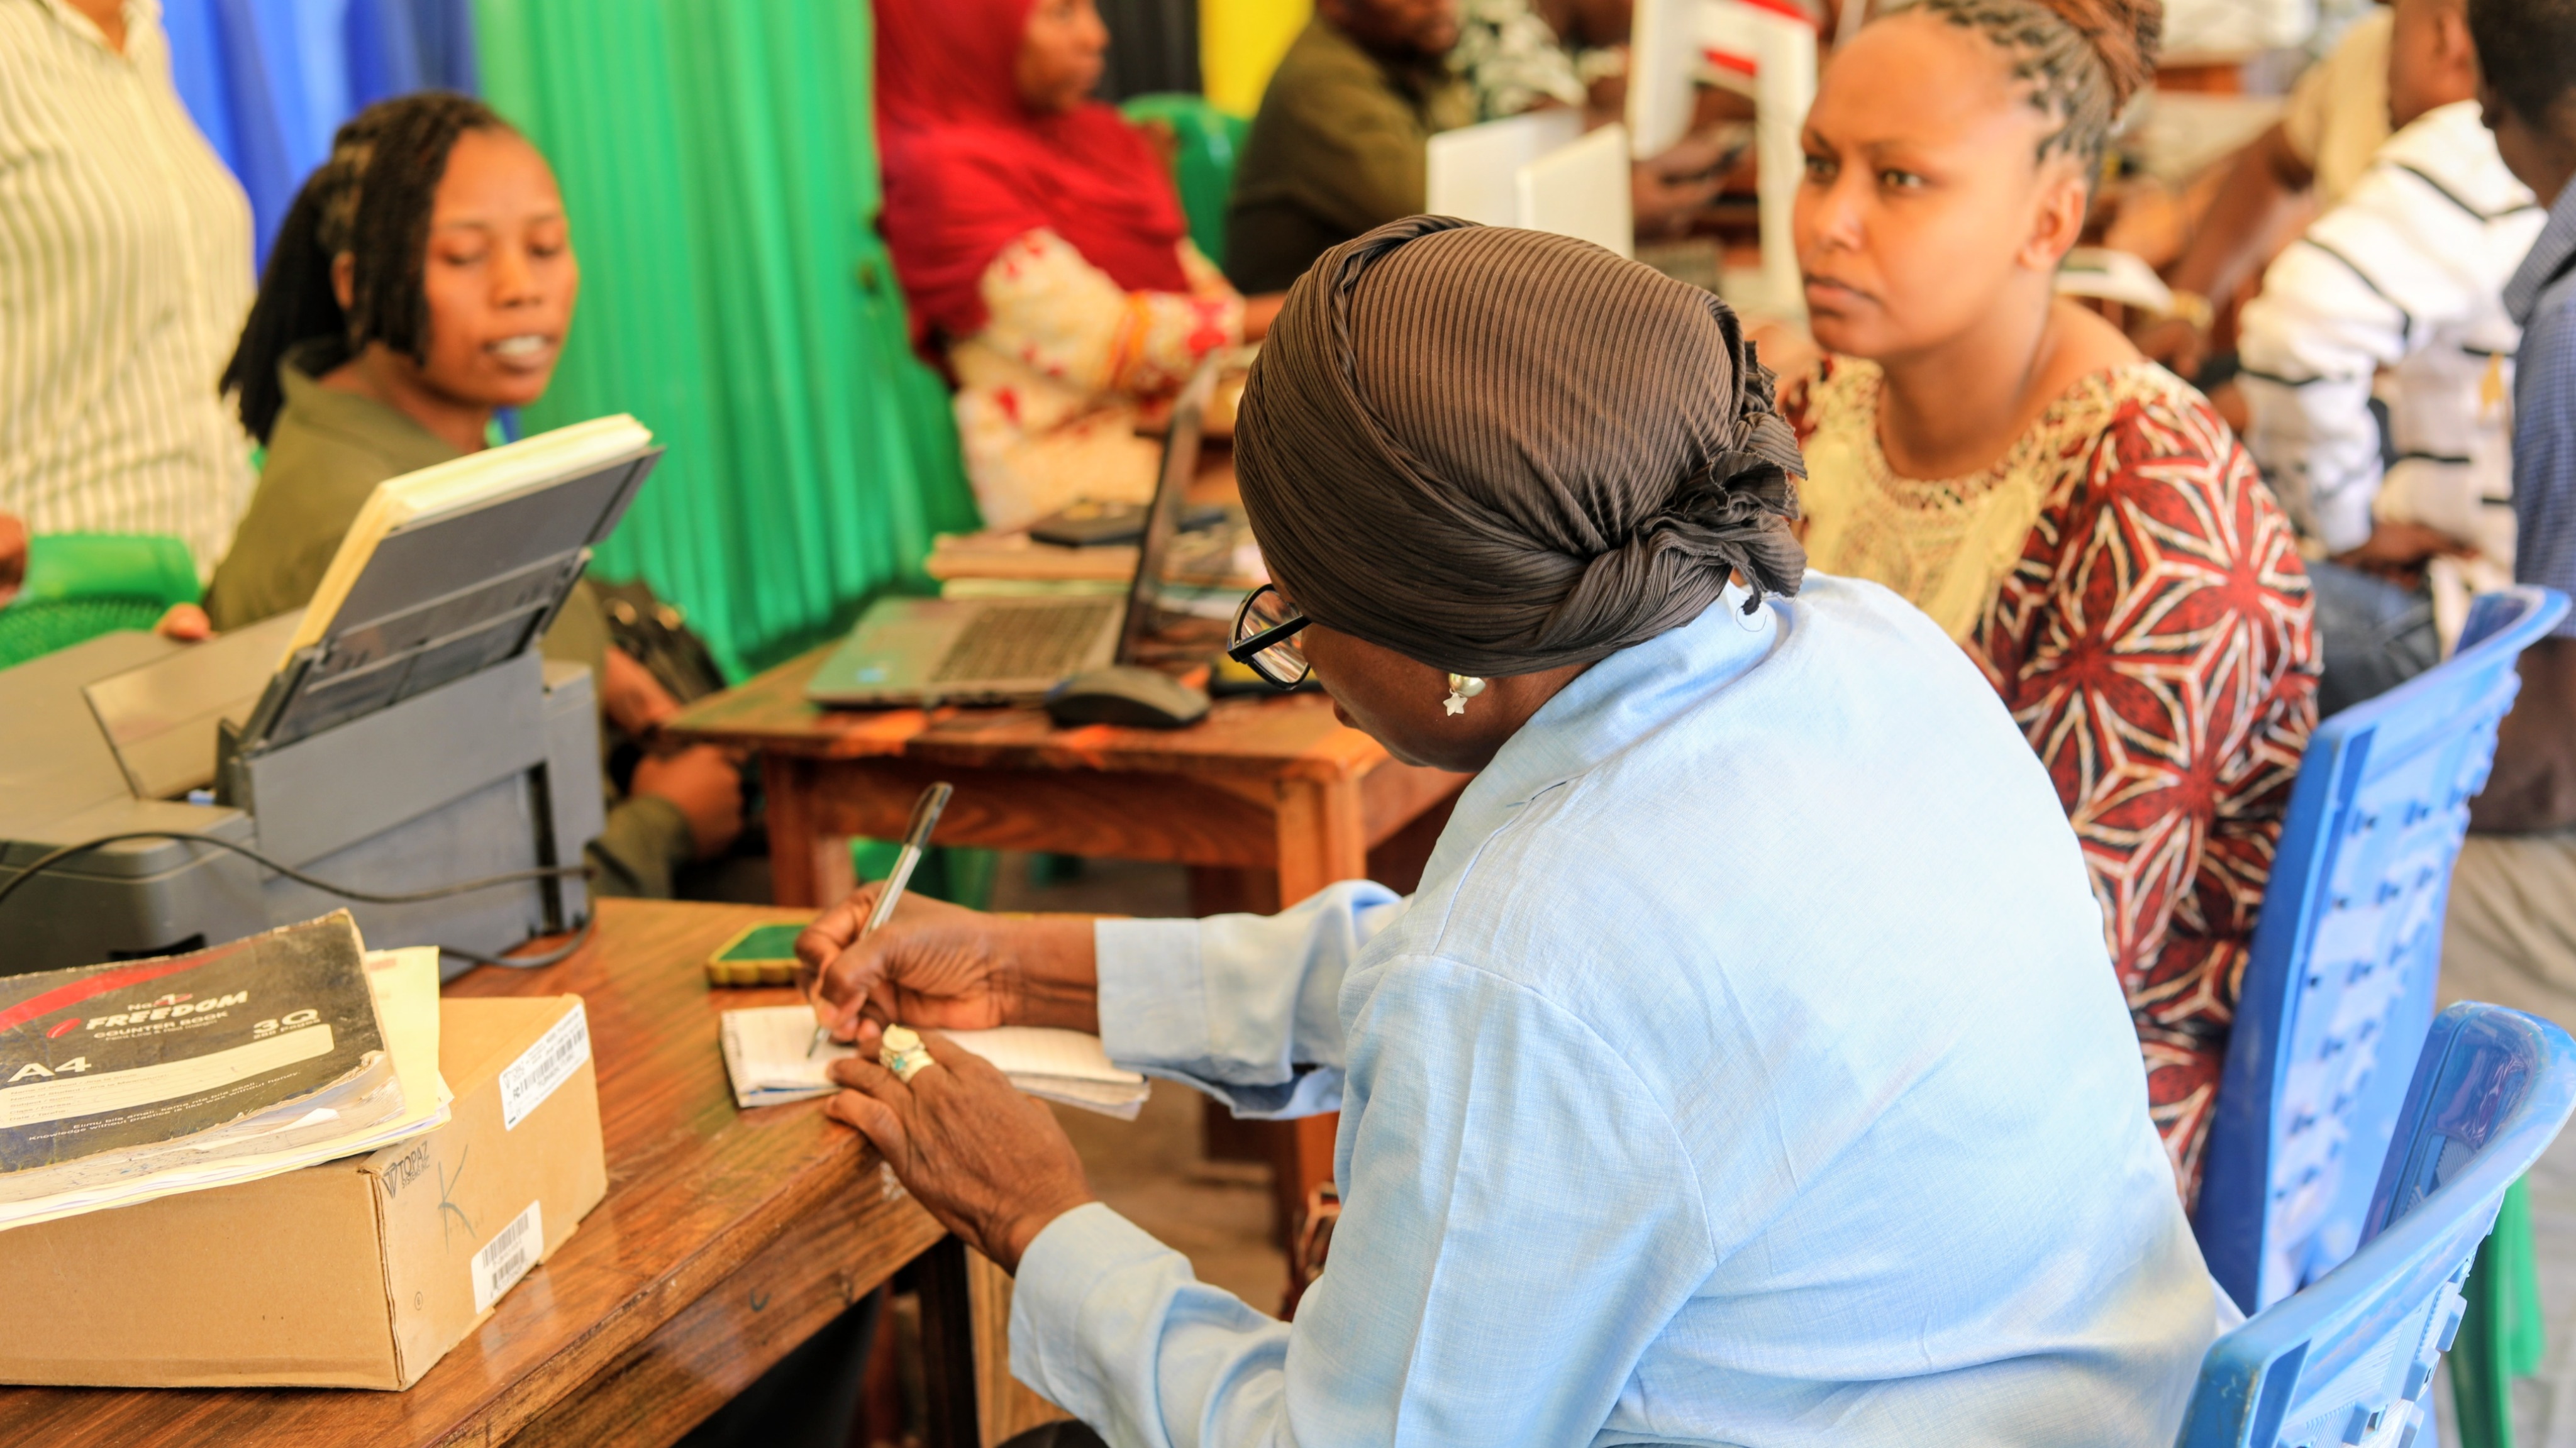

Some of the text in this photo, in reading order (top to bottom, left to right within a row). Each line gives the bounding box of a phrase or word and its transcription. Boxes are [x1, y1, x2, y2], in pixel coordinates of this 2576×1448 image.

[86, 990, 248, 1030] FREEDOM
[94, 1010, 229, 1039] COUNTER BOOK
[7, 1056, 92, 1083] A4
[29, 1127, 87, 1141] Knowledge
[90, 1120, 126, 1130] without
[130, 1110, 170, 1123] practice
[229, 1082, 264, 1096] without
[73, 1121, 102, 1129] Elimu
[211, 1091, 228, 1099] bila
[397, 1140, 429, 1182] TOPAZ
[402, 1169, 421, 1189] SYSTEMS
